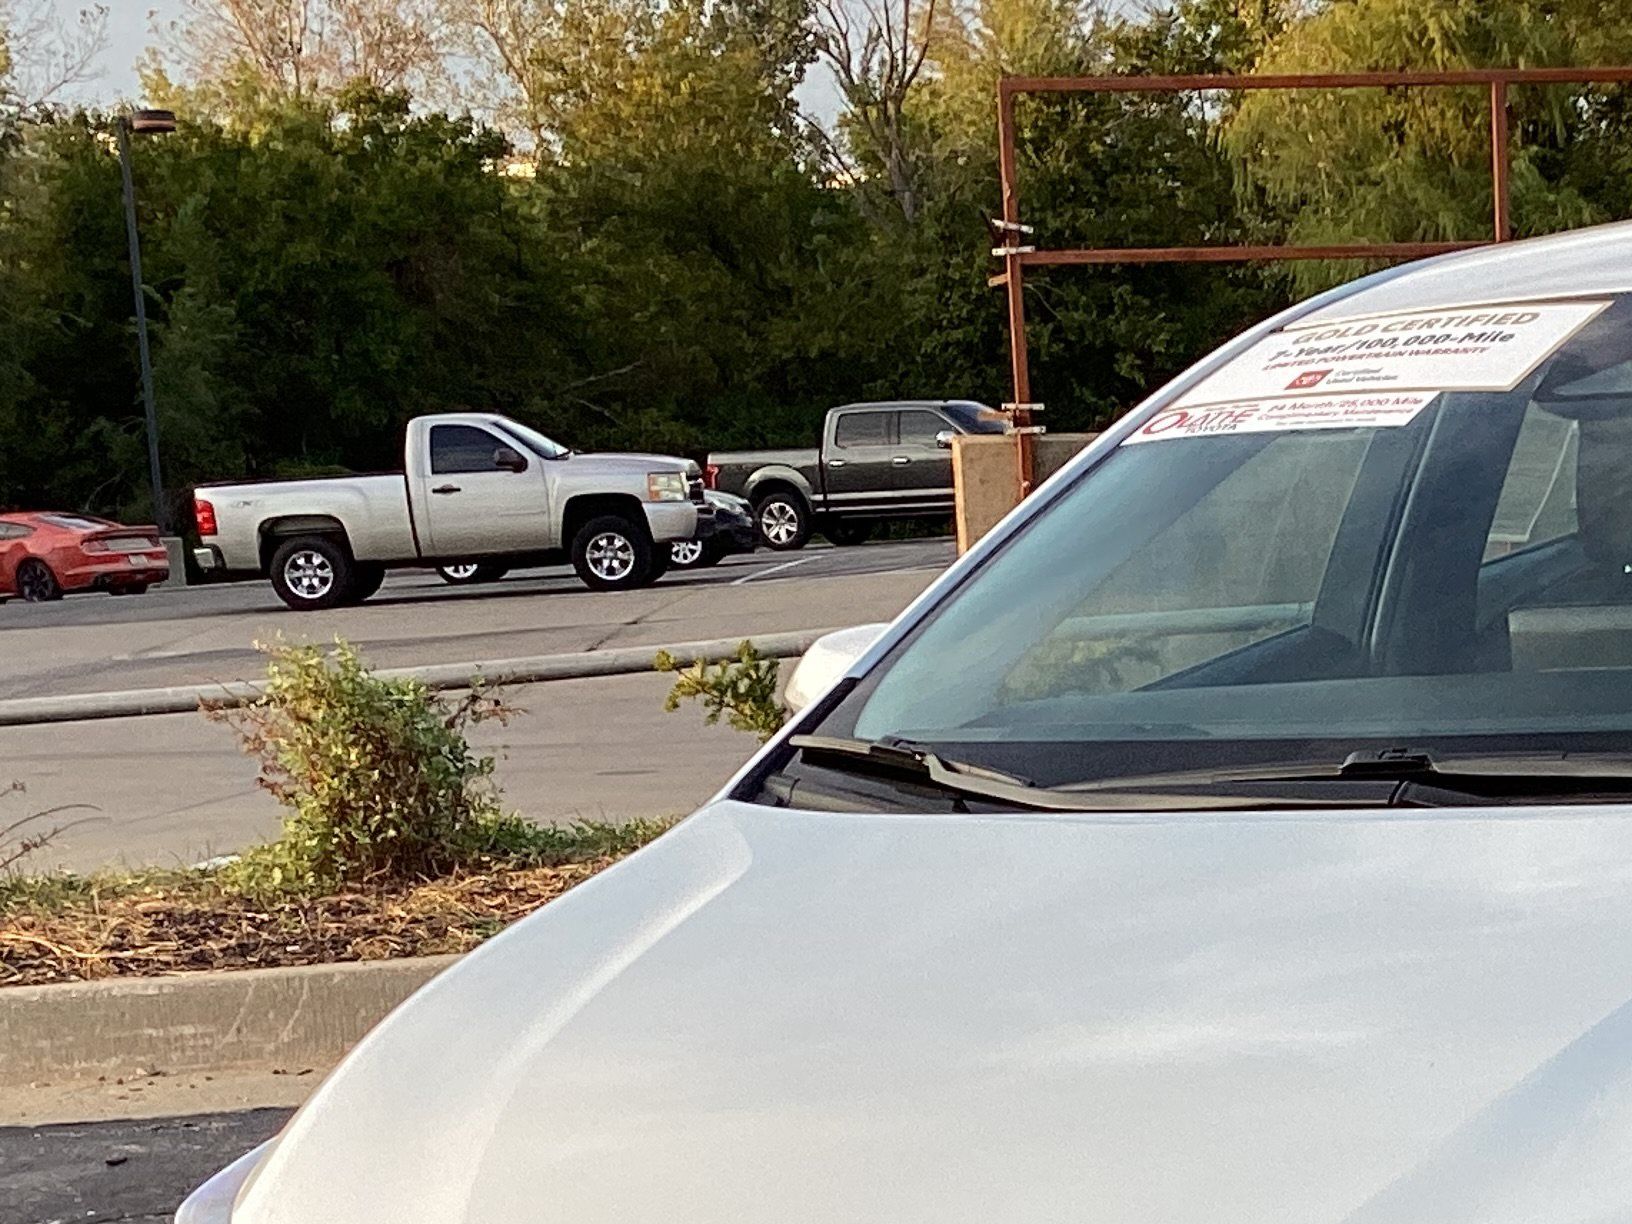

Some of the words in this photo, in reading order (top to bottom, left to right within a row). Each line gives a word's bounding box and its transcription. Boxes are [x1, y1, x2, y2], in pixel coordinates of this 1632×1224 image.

[1292, 323, 1380, 345] GOLD
[1381, 312, 1540, 333] CERTIFIED
[1315, 350, 1407, 363] POWERTRAIN
[1408, 346, 1490, 357] WARRANTY
